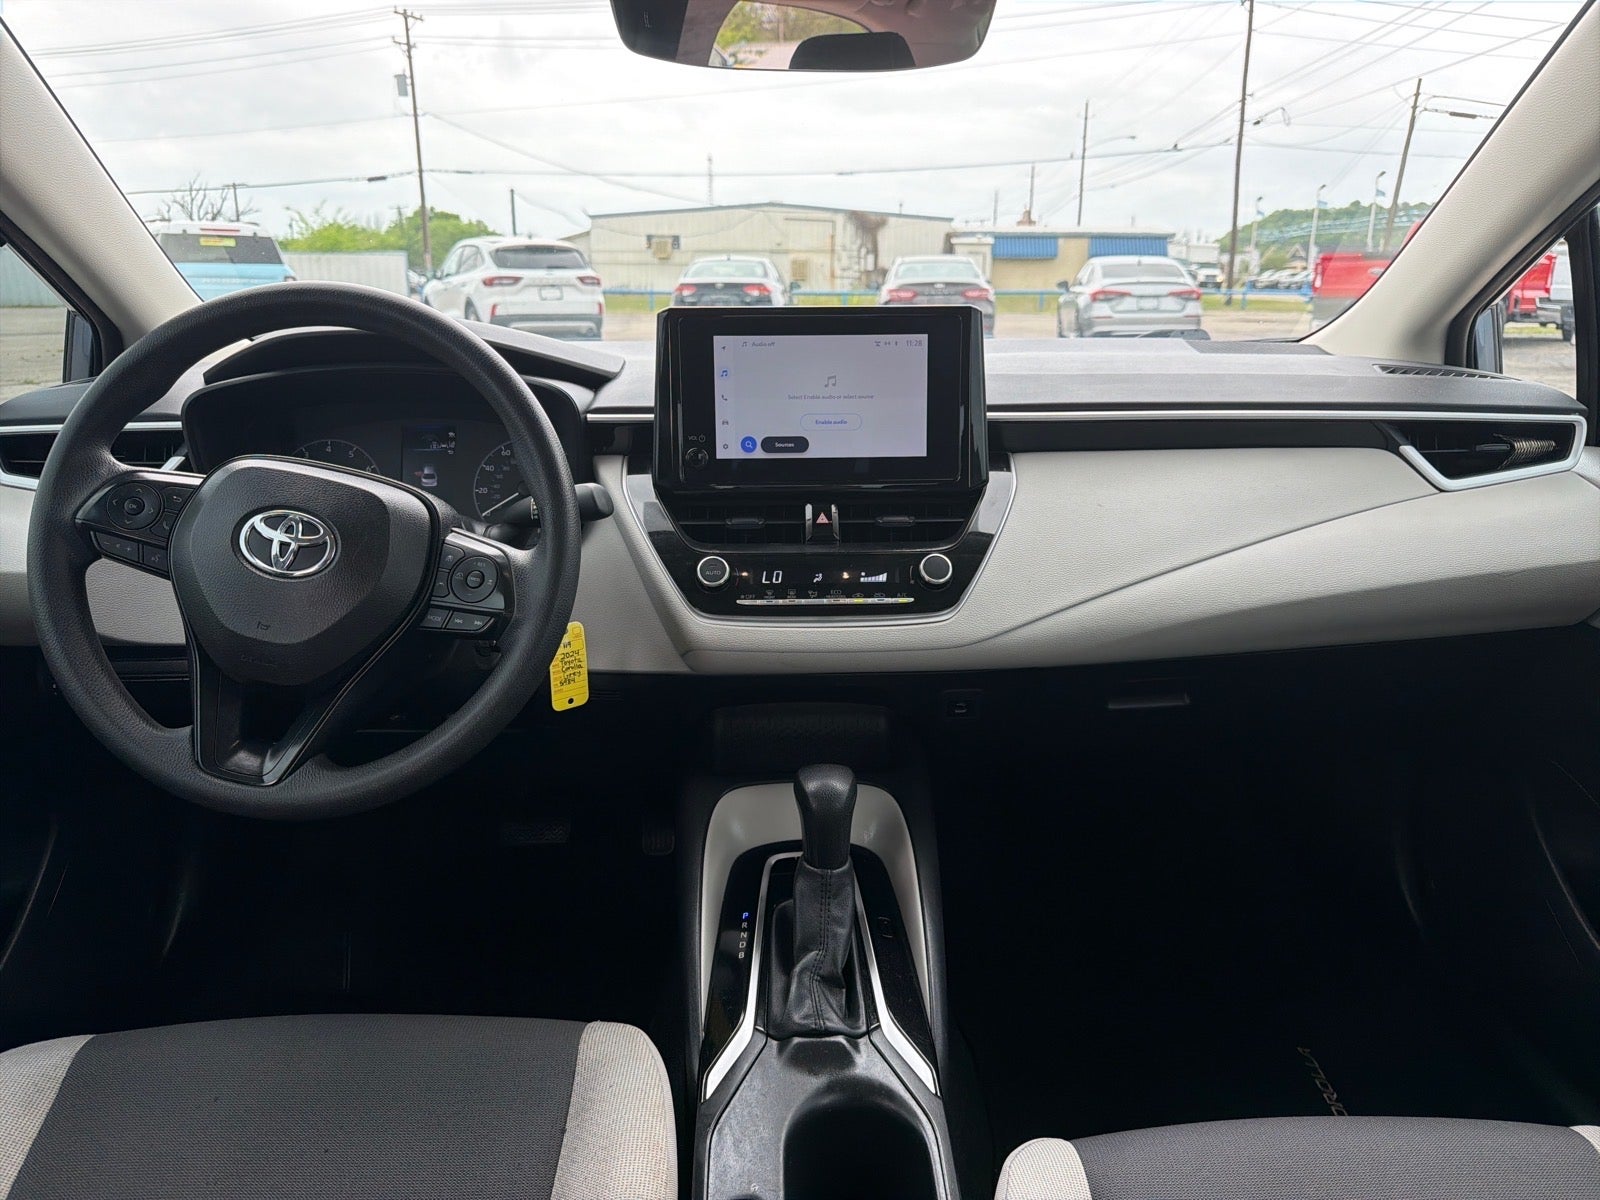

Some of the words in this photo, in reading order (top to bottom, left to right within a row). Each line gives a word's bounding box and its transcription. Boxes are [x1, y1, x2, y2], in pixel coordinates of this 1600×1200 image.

[775, 441, 795, 449] Sources
[762, 570, 783, 584] LO
[560, 650, 580, 660] 2024
[742, 912, 749, 920] P
[738, 951, 745, 959] B
